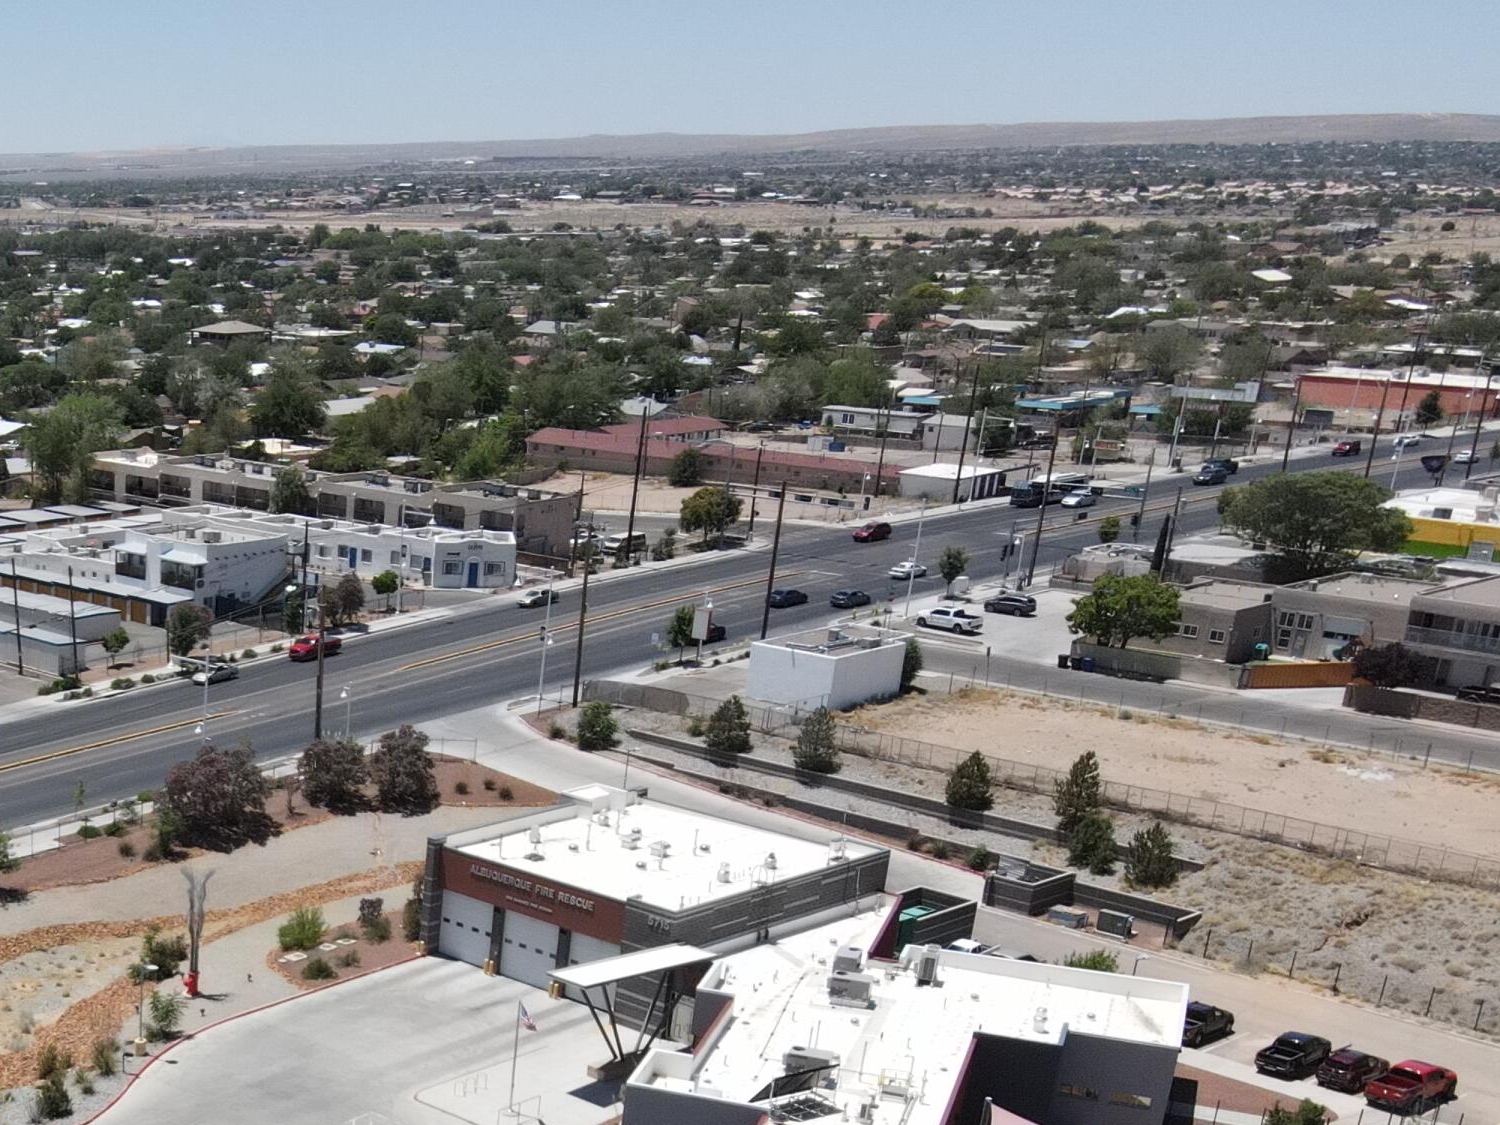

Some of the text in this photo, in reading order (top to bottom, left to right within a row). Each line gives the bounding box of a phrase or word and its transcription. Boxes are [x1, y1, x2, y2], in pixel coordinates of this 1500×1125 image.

[470, 863, 533, 892] ALBUQUERQUE
[534, 883, 555, 899] FIRE
[557, 891, 596, 912] RESCUE
[647, 916, 670, 932] 5715
